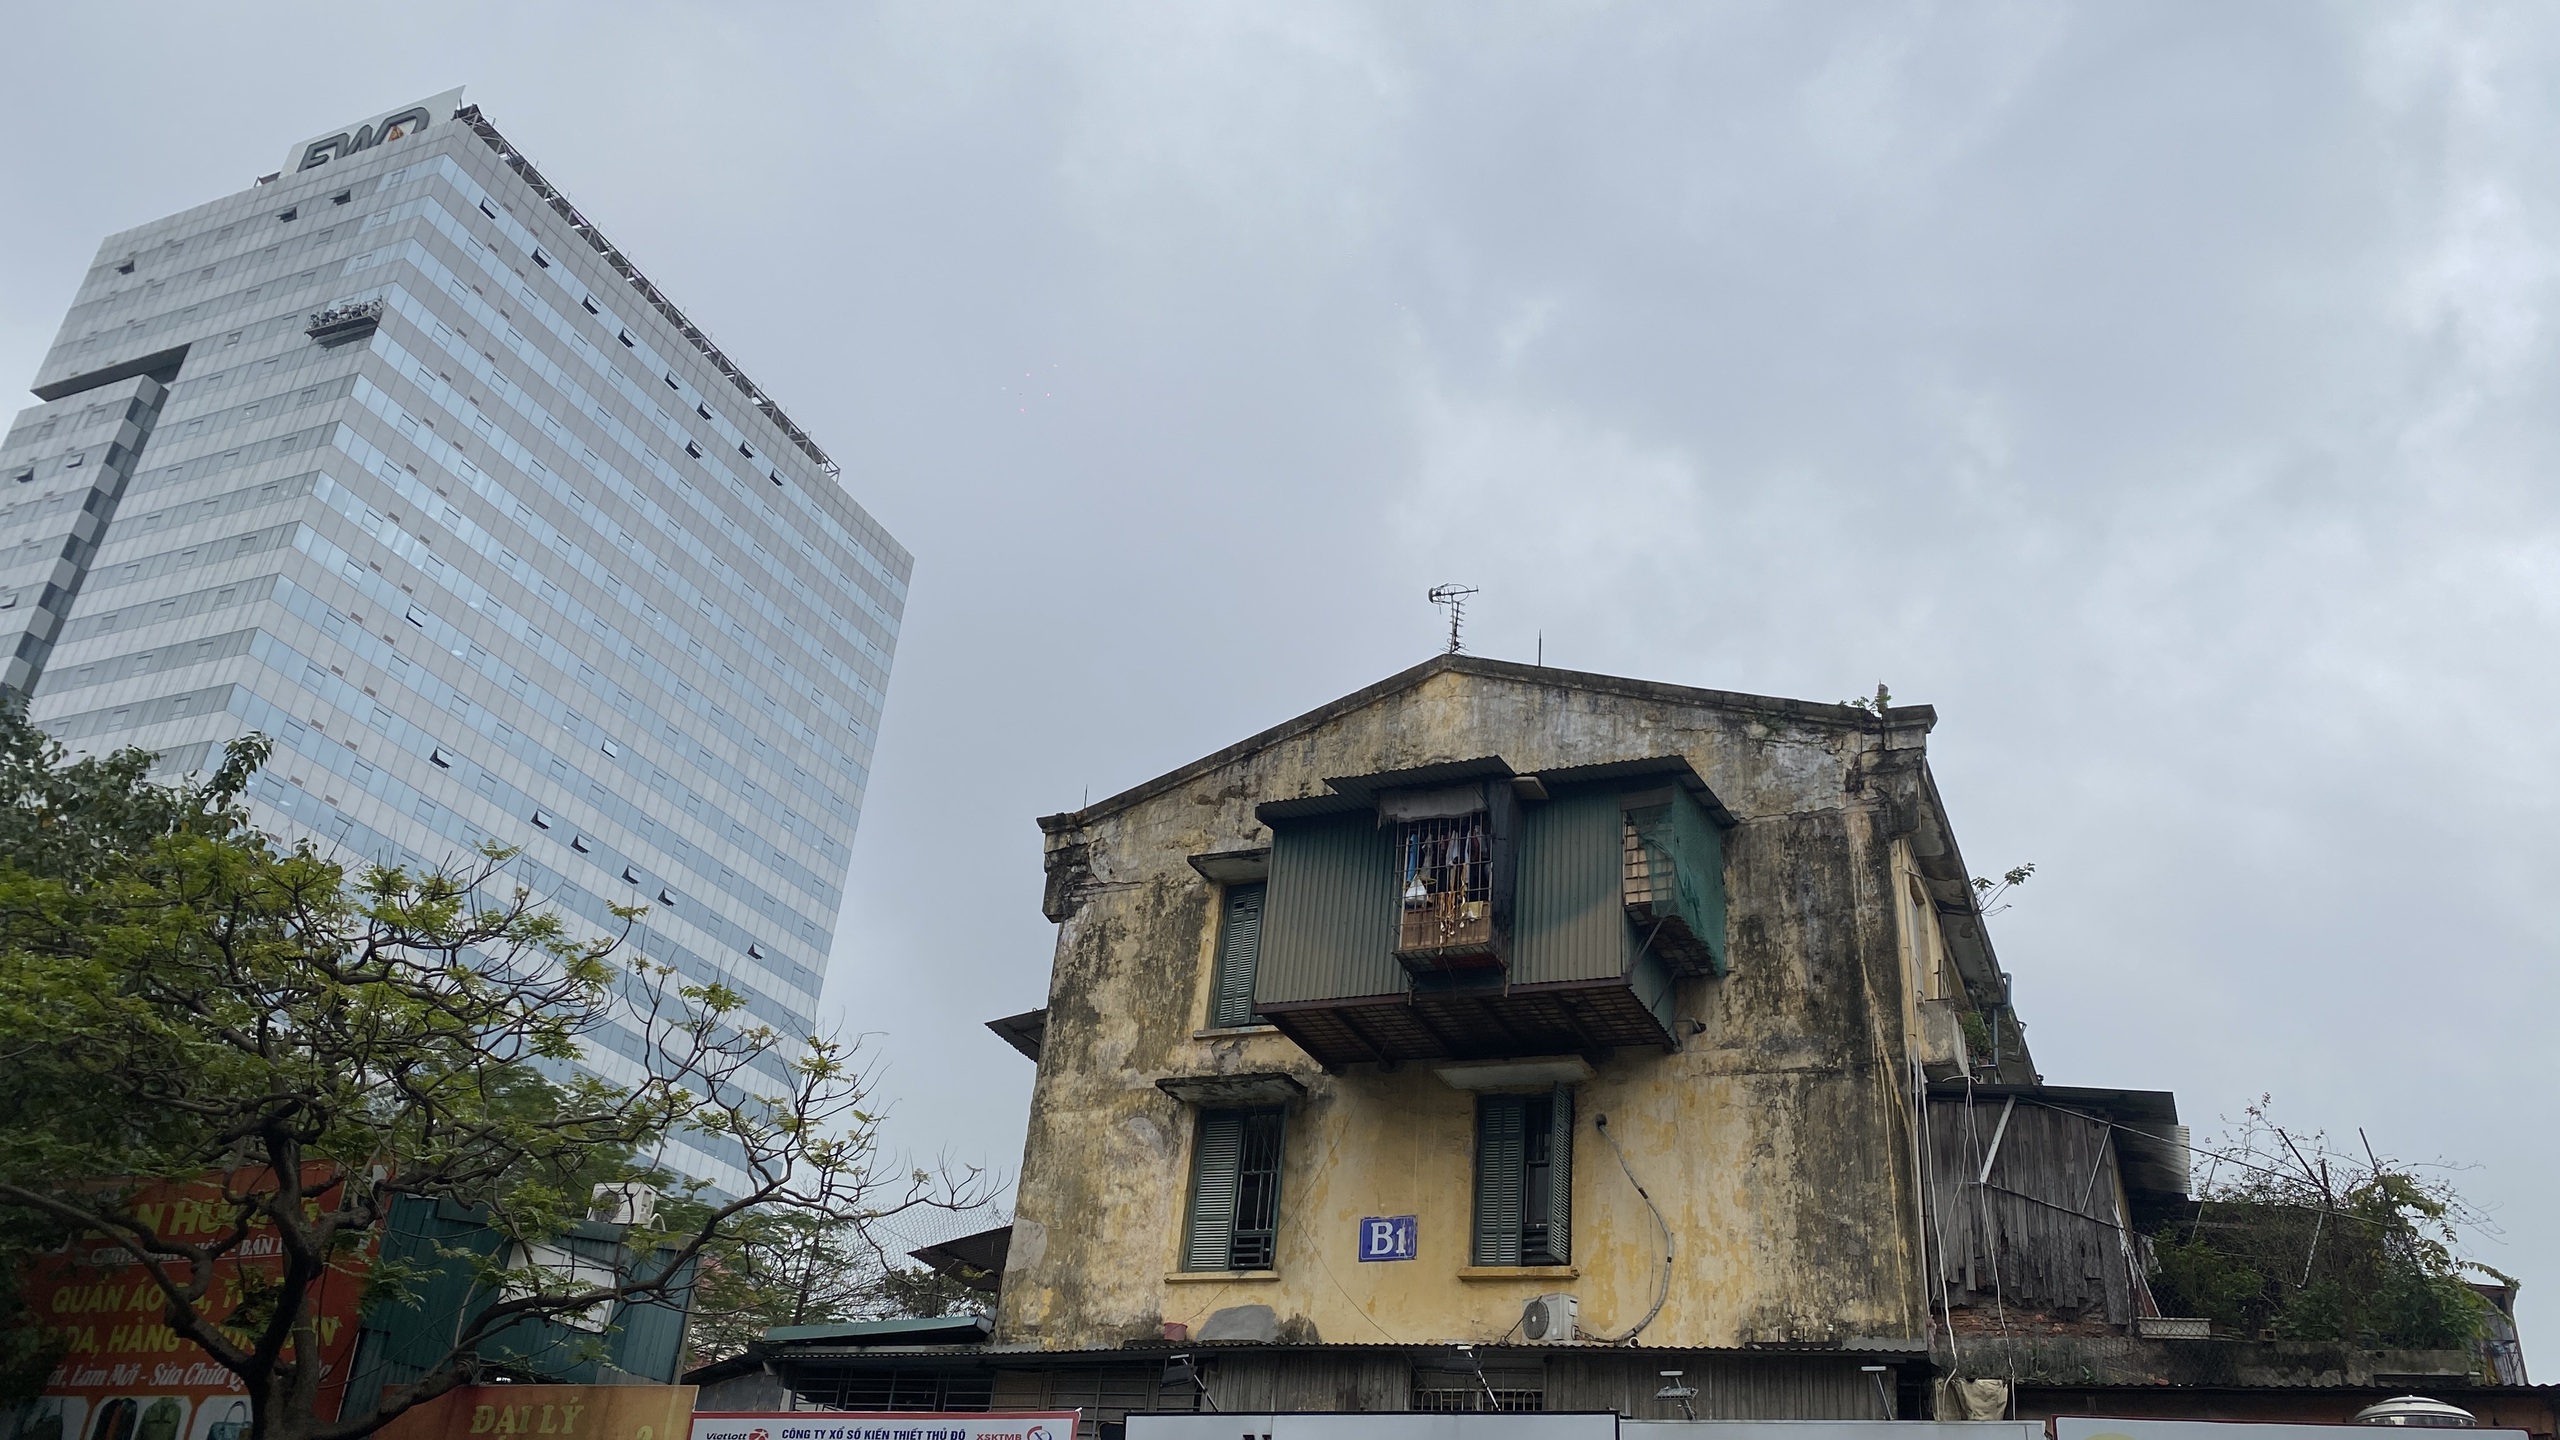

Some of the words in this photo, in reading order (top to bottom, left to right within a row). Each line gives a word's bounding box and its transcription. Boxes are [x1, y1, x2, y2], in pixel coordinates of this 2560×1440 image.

[1370, 1222, 1406, 1254] B1
[125, 1276, 166, 1312] ÁO
[107, 1316, 180, 1353] HÀNG
[538, 1396, 585, 1434] LÝ
[782, 1427, 811, 1439] CÔNG
[814, 1429, 827, 1439] TY
[829, 1426, 845, 1439] XỔ
[846, 1426, 862, 1439] SỐ
[864, 1427, 890, 1440] KIẾN
[893, 1427, 924, 1440] THIẾT
[926, 1427, 948, 1440] THỦ
[950, 1428, 966, 1440] ĐÔ
